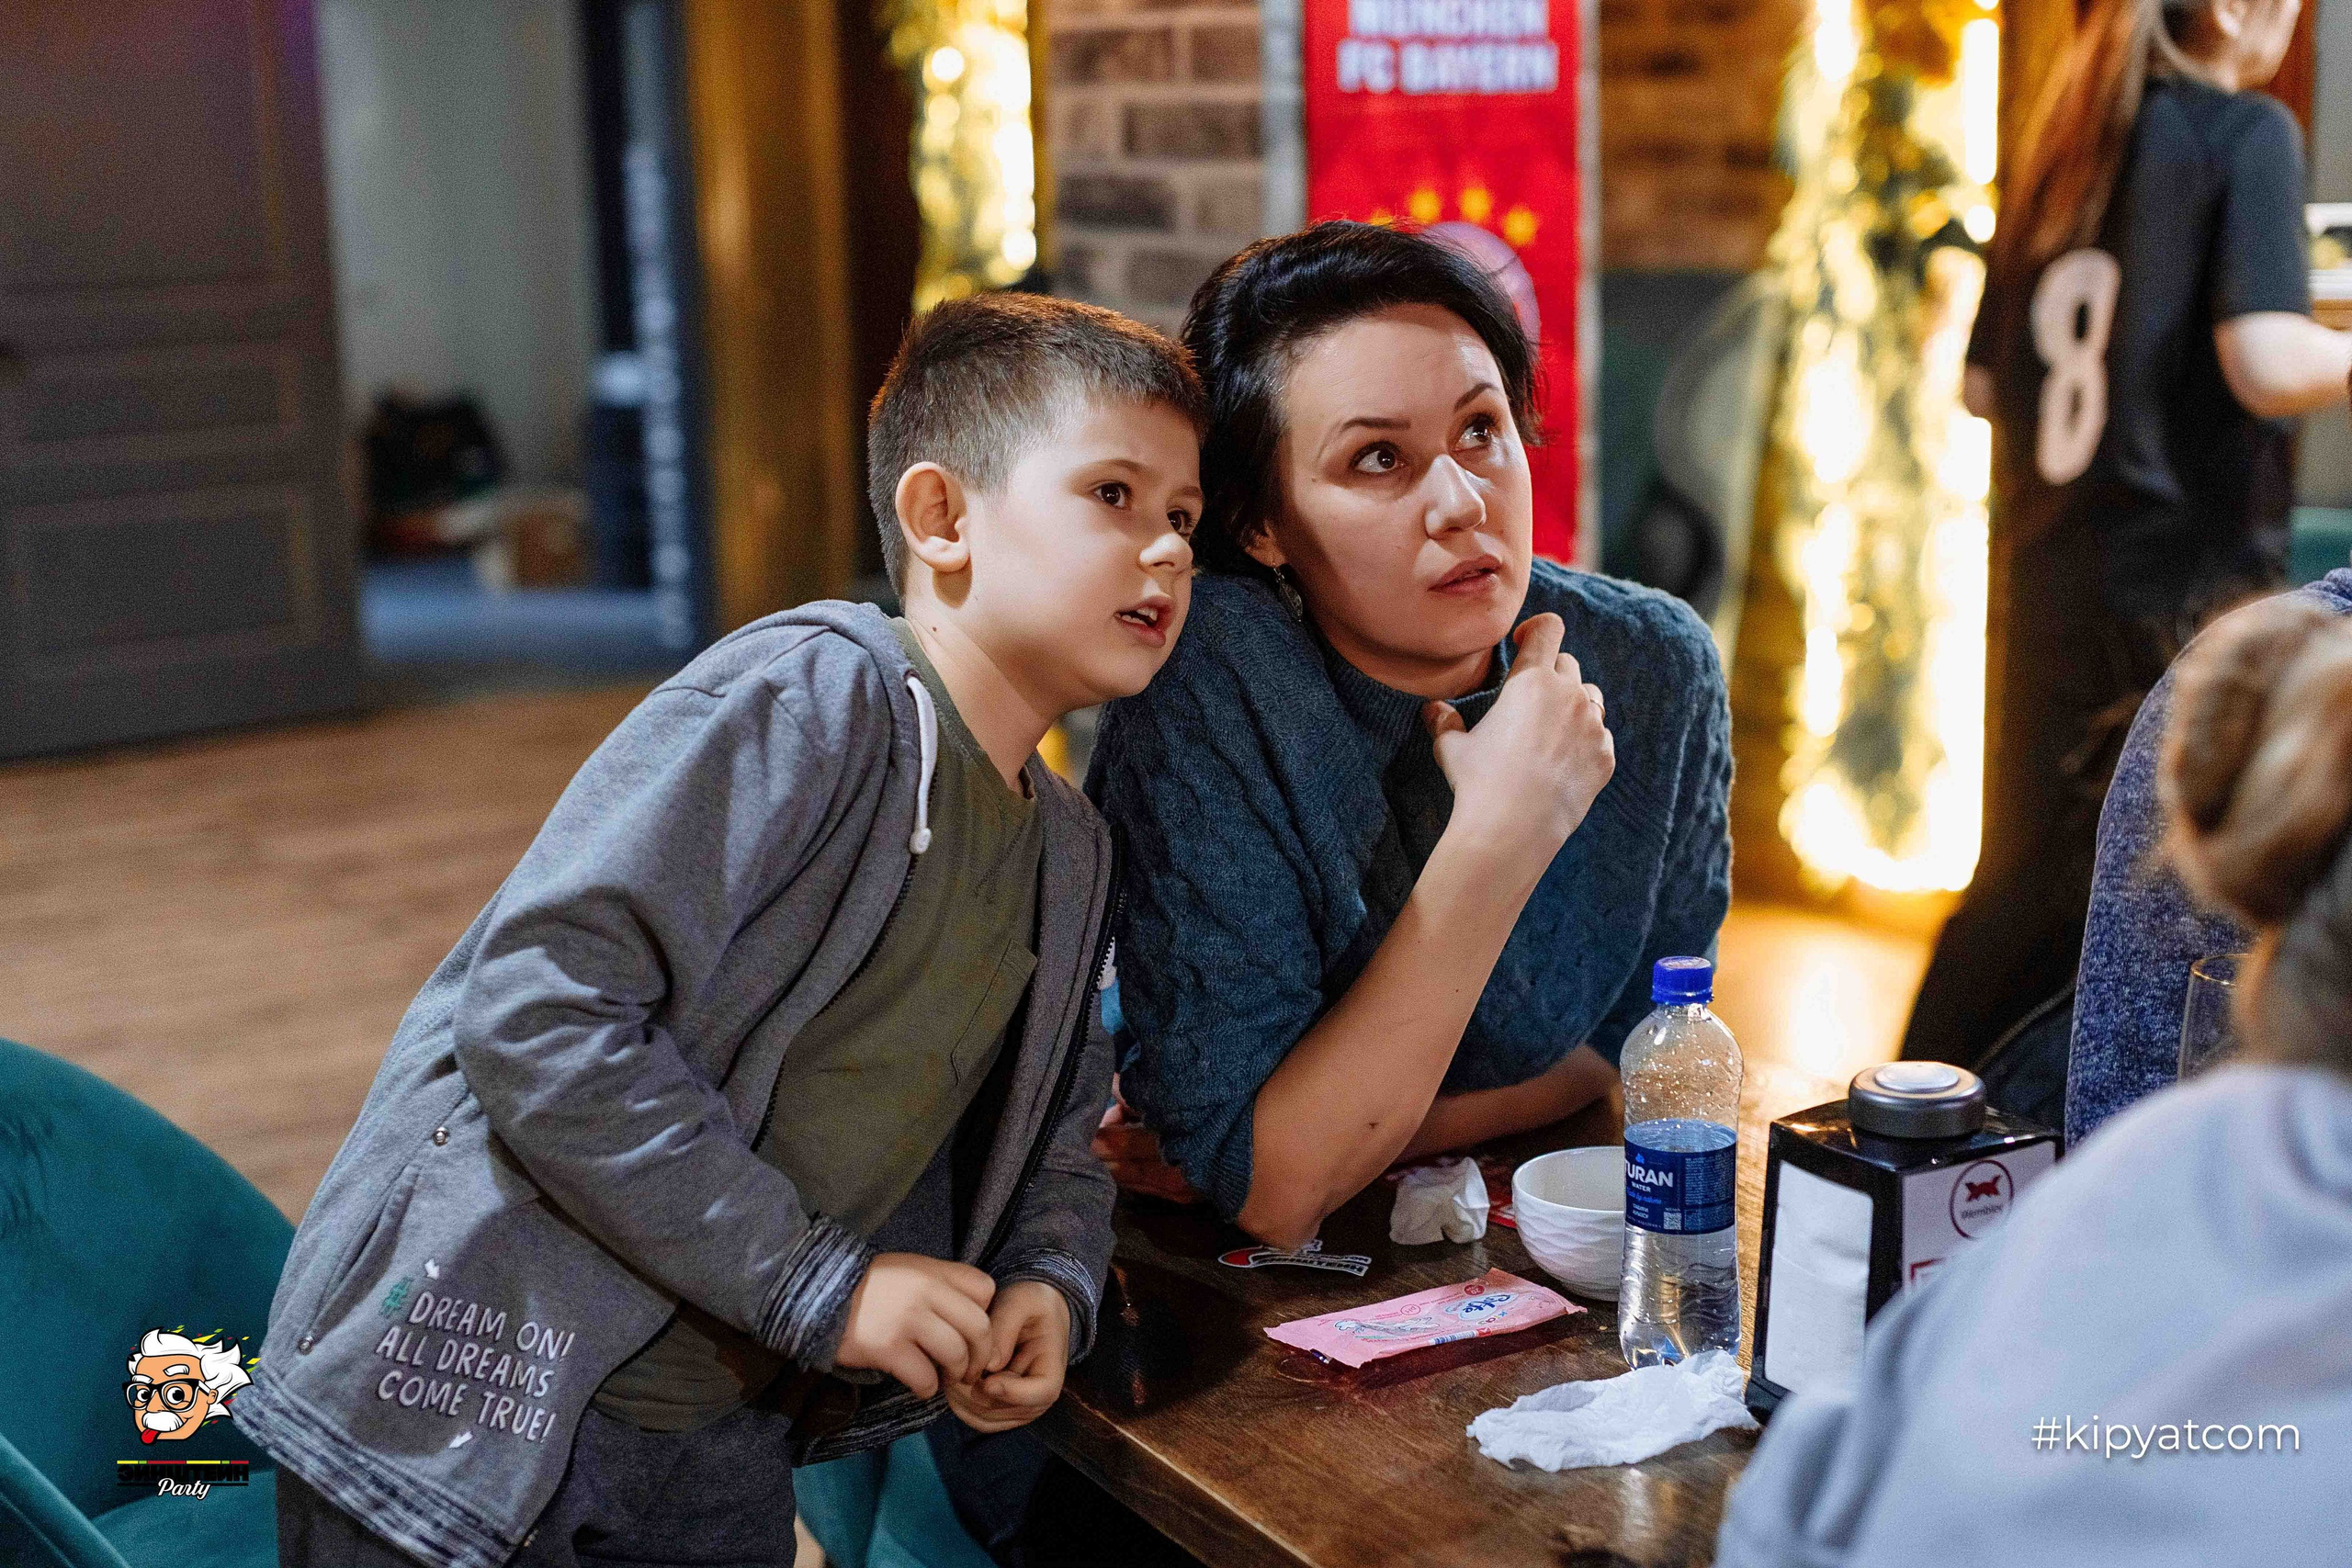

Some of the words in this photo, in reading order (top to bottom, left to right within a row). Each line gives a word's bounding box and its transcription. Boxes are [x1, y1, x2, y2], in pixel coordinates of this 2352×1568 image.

[1337, 39, 1394, 93] FC
[1399, 41, 1558, 95] BAYERN
[2030, 248, 2120, 485] 8
[376, 1325, 427, 1366] ALL
[435, 1338, 555, 1397] DREAMS
[516, 1321, 576, 1362] ON!
[378, 1370, 468, 1416] COME
[478, 1391, 557, 1443] TRUE!
